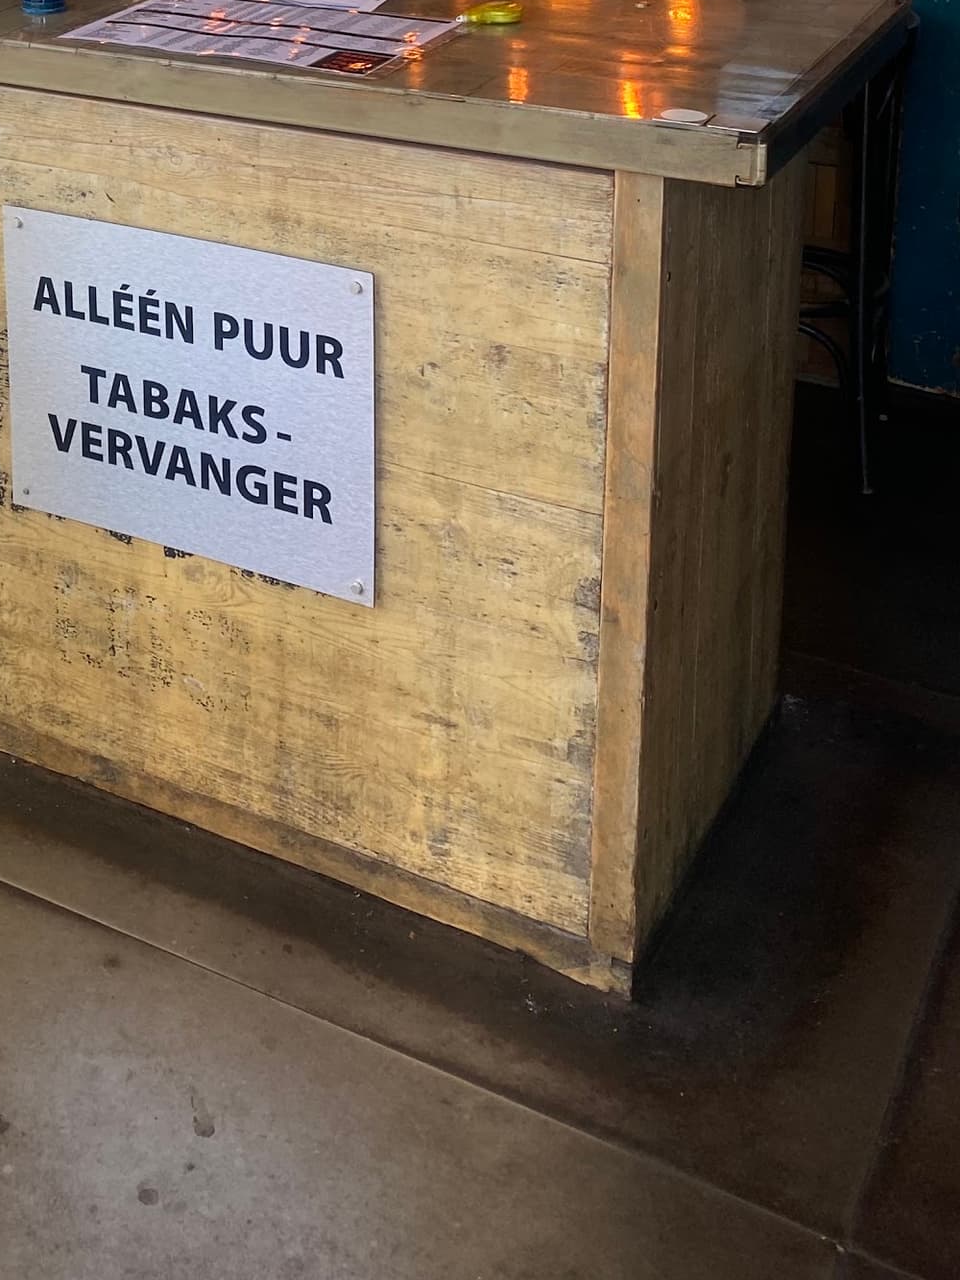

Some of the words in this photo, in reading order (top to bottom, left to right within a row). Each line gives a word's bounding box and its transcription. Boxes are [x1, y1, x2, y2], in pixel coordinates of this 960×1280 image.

[33, 275, 195, 344] ALLÉÉN
[213, 311, 345, 379] PUUR
[80, 364, 292, 445] TABAKS-
[47, 412, 333, 525] VERVANGER
